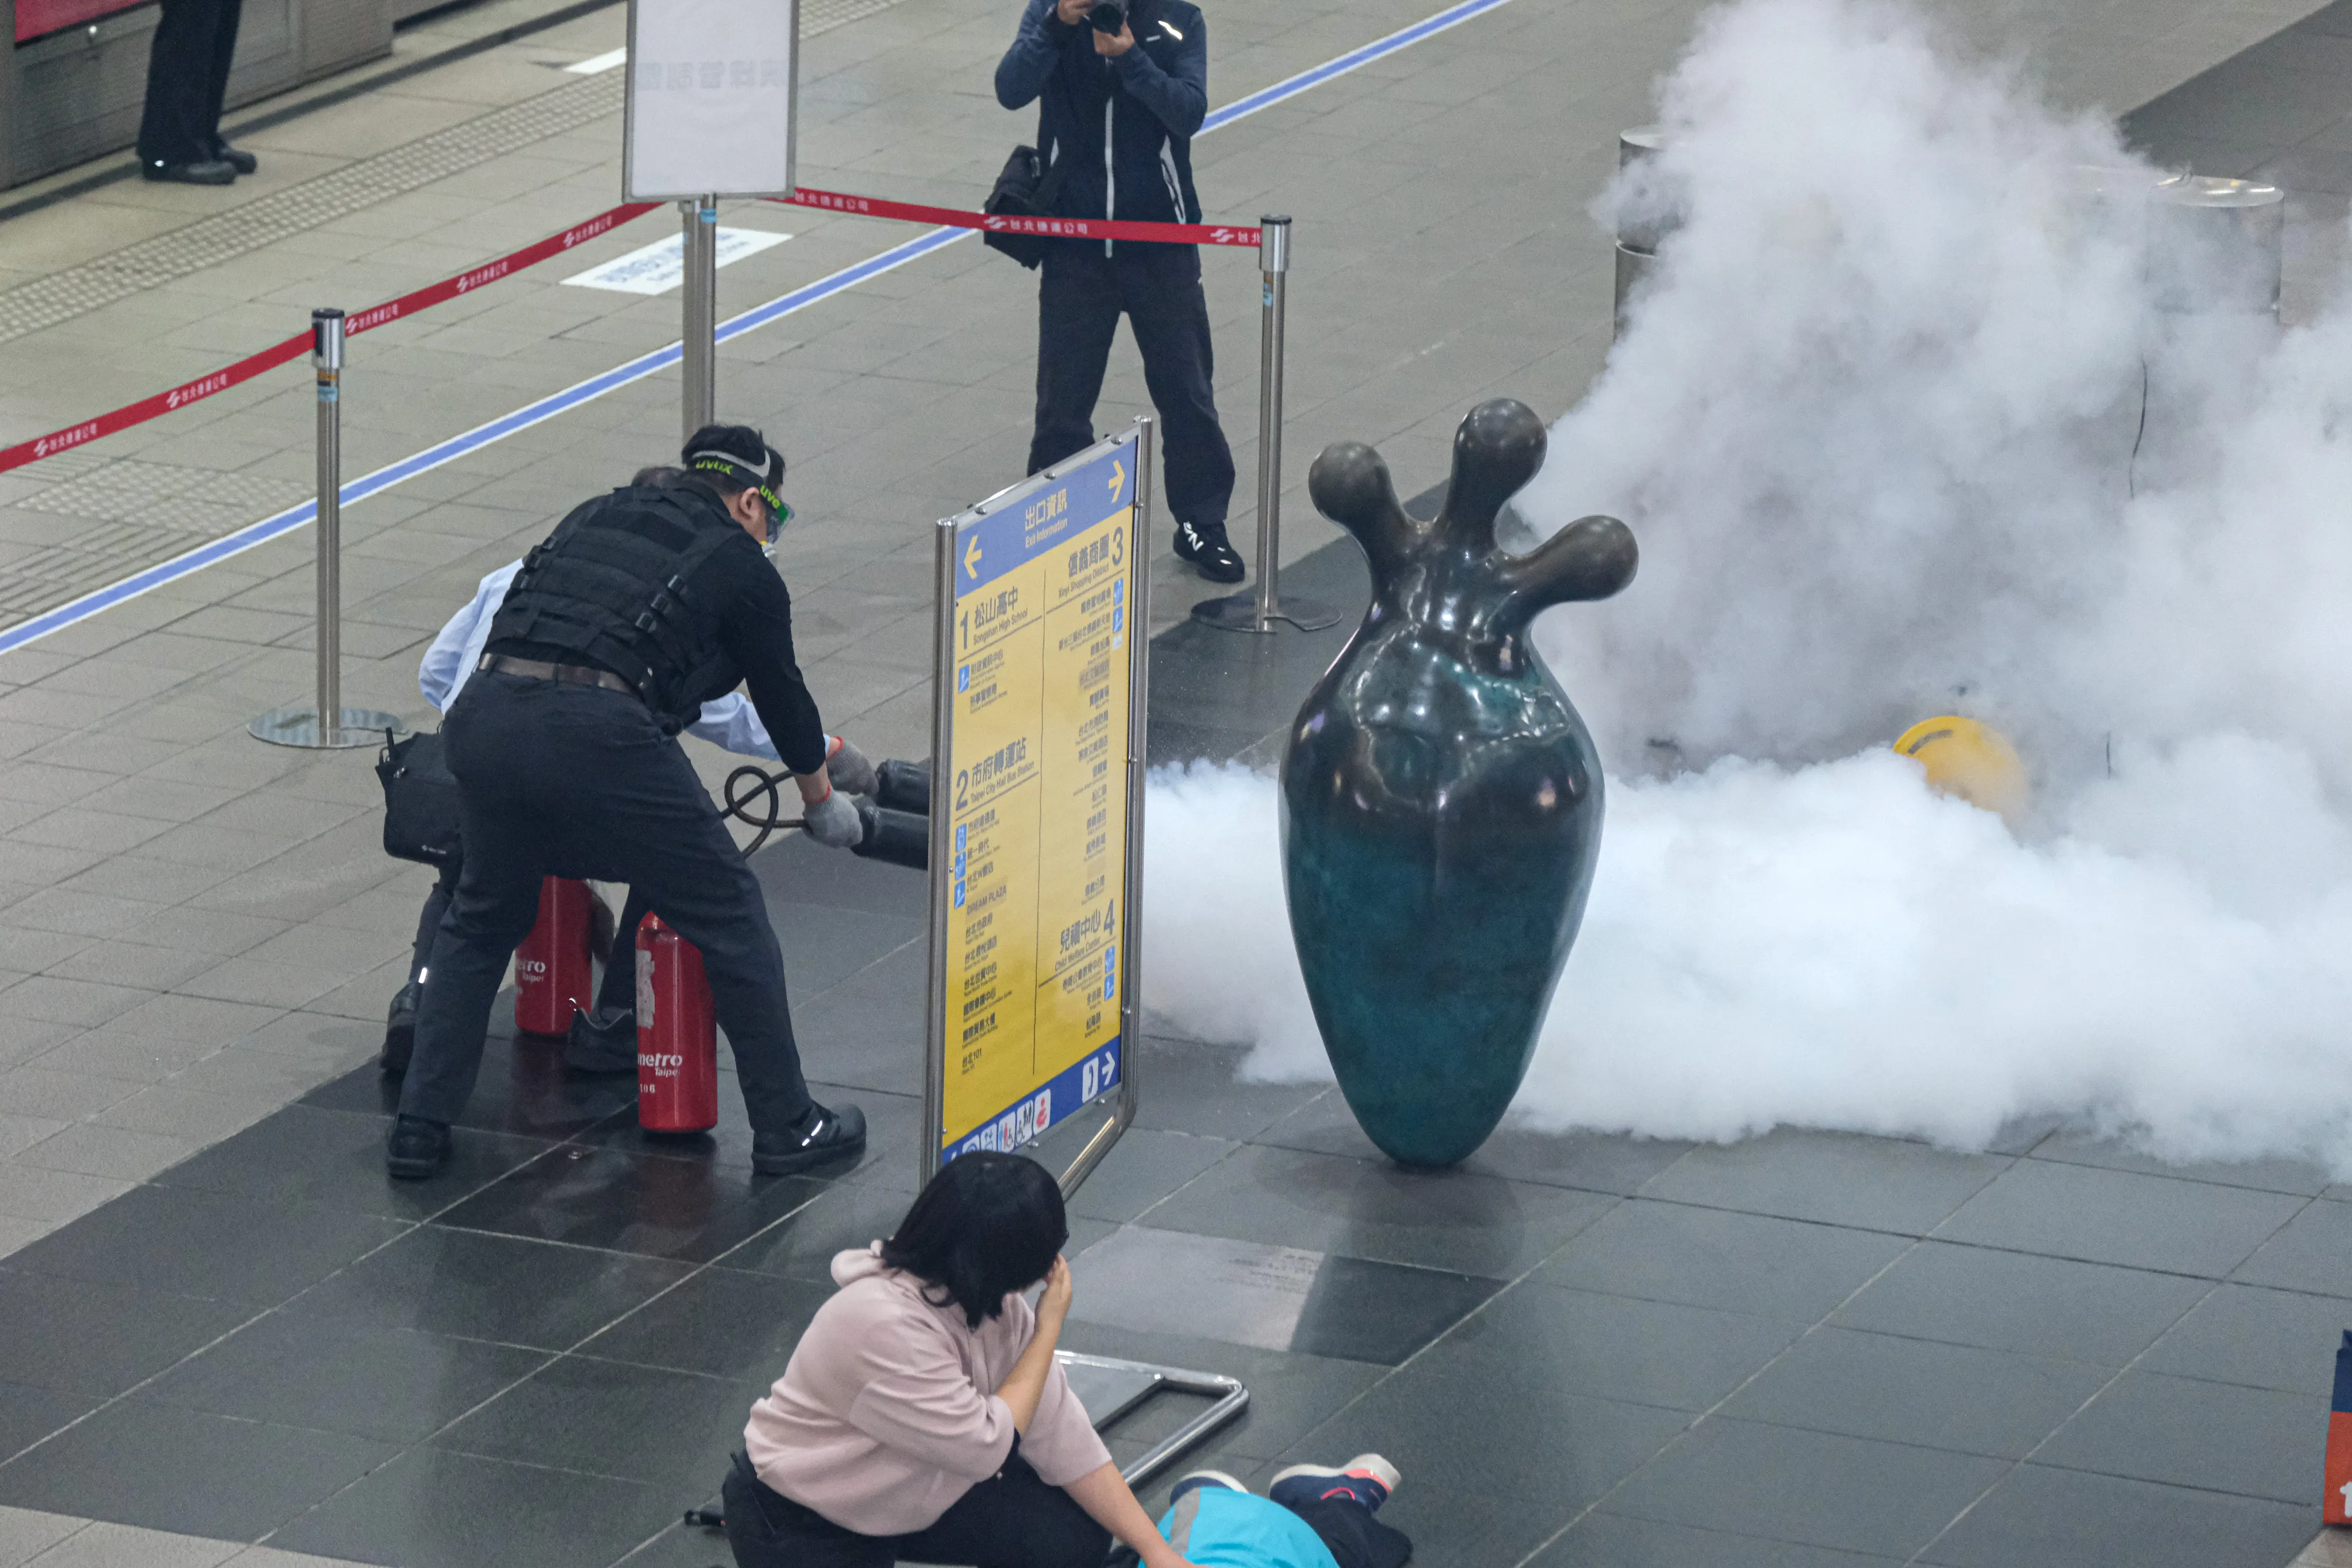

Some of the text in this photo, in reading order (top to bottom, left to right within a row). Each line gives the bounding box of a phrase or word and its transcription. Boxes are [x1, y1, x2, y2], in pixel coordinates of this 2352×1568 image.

[1010, 220, 1088, 235] 台北捷運公司
[1025, 489, 1067, 531] 出口資訊
[1025, 517, 1068, 549] Exit Information
[1112, 525, 1123, 567] 3
[1068, 534, 1109, 579] 信義商圈
[1071, 572, 1091, 593] Shopping
[973, 607, 1027, 648] Songshan High School
[974, 584, 1018, 630] 松山高中
[960, 611, 968, 652] 1
[972, 735, 1026, 790] 市府轉運站
[956, 768, 968, 812] 2
[970, 787, 984, 805] Taipei
[985, 781, 995, 797] City
[997, 775, 1005, 789] Hall
[967, 896, 987, 916] DREAM
[988, 884, 1006, 903] PLAZA
[1103, 897, 1115, 939] 4
[1055, 935, 1100, 972] Child Welfare Center
